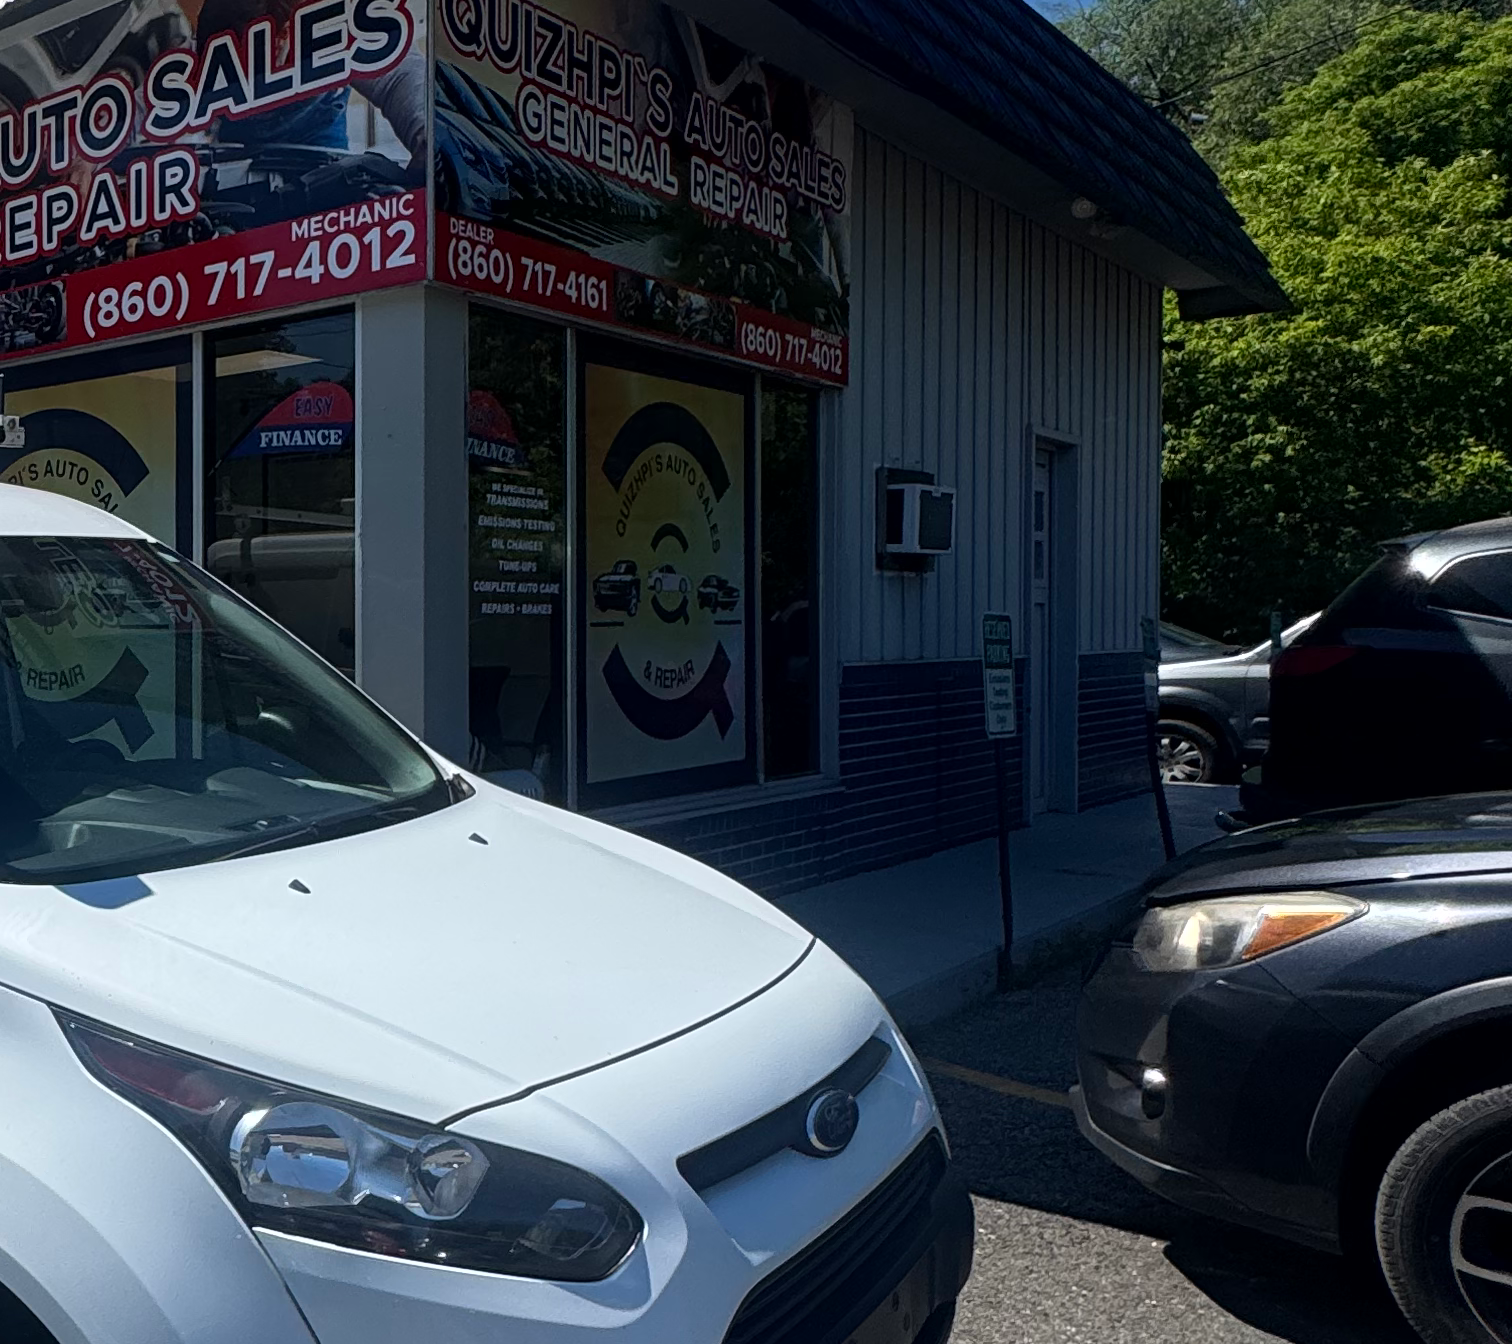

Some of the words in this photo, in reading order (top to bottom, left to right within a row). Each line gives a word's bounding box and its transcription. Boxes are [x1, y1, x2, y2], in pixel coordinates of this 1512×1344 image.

[518, 85, 679, 196] GENERAL
[688, 155, 788, 240] REPAIR
[684, 92, 767, 174] AUTO
[768, 131, 847, 213] SALES
[291, 194, 414, 242] MECHANIC
[449, 216, 495, 245] DEALER
[83, 271, 190, 338] (860)
[203, 220, 416, 306] 717-4012
[448, 238, 514, 294] (860)
[520, 257, 608, 312] 717-4161
[740, 321, 782, 363] (860)
[785, 337, 843, 375] 717-4012
[294, 394, 335, 418] EASY
[259, 429, 342, 447] FINANCE
[44, 459, 89, 486] AUTO
[665, 454, 697, 486] AUTO
[696, 482, 721, 554] SALES
[491, 537, 505, 550] OIL
[473, 580, 517, 593] COMPLETE
[517, 581, 539, 594] AUTO
[26, 664, 85, 691] REPAIR
[644, 660, 652, 678] &
[654, 659, 695, 689] REPAIR
